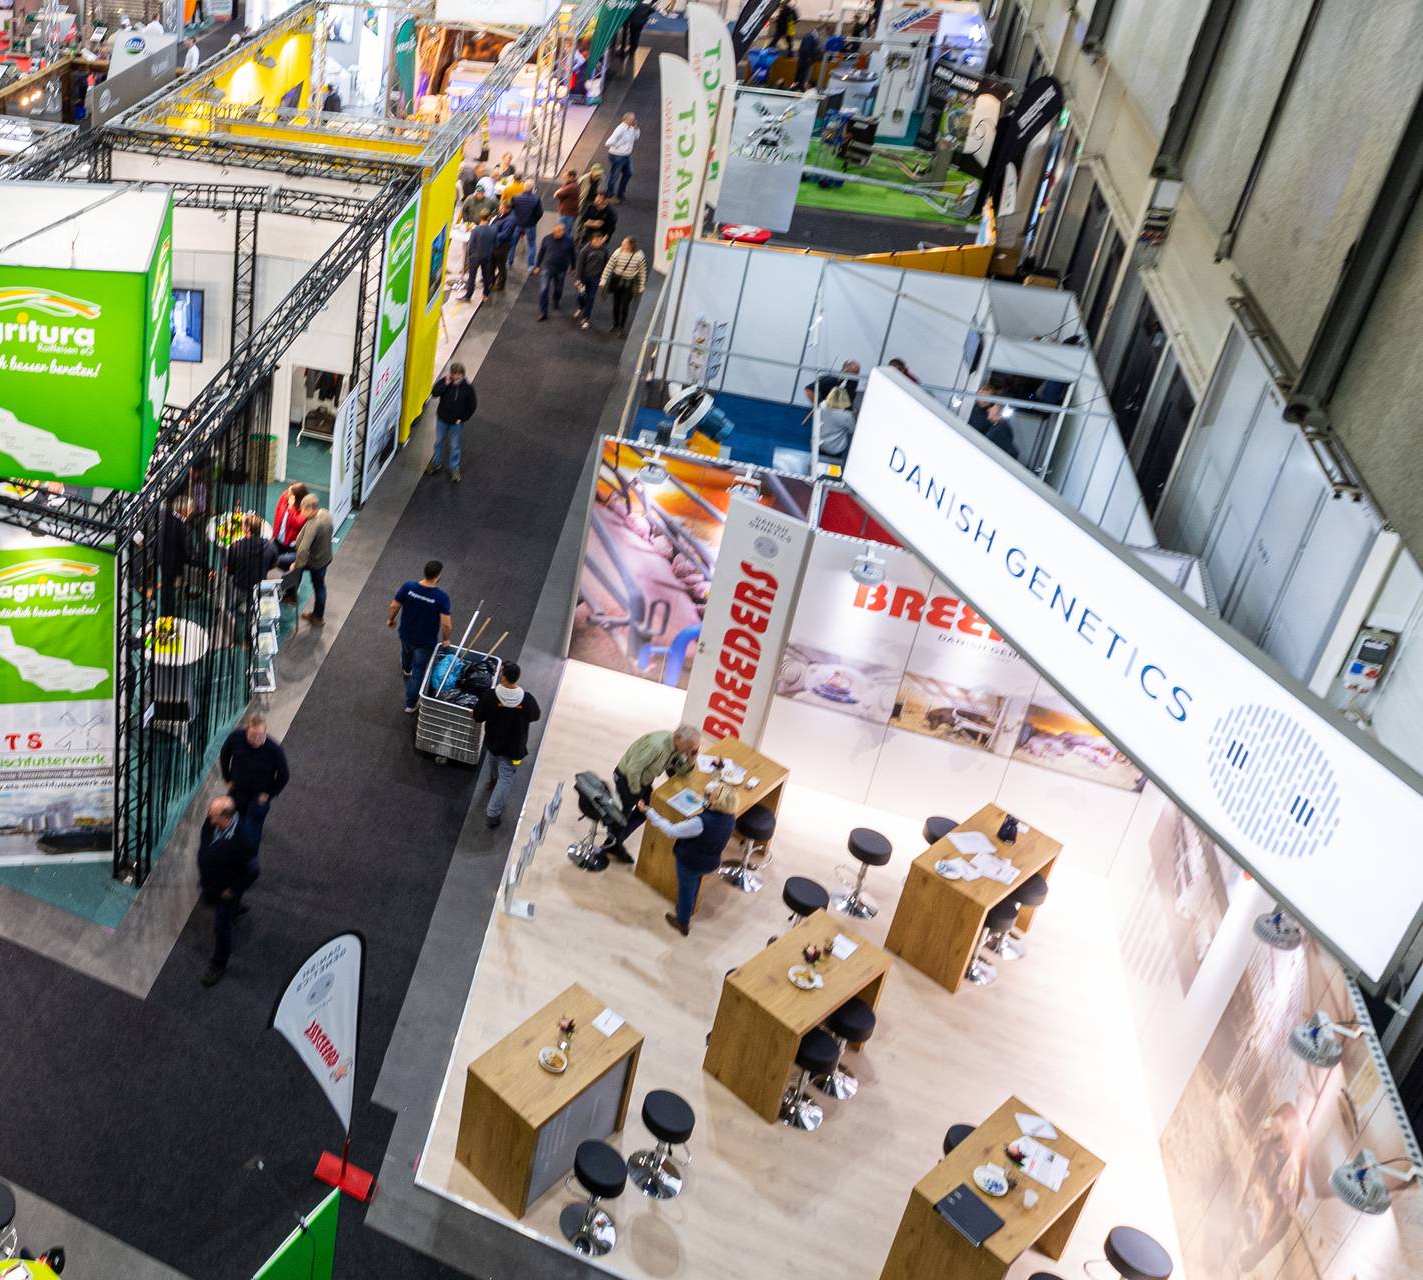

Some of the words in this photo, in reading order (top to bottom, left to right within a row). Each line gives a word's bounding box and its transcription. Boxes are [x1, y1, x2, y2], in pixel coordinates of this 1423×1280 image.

[10, 355, 48, 373] besser
[49, 358, 102, 378] beraten!
[853, 583, 1008, 644] BREE
[889, 446, 997, 553] DANISH
[1005, 547, 1193, 723] GENETICS
[702, 560, 780, 742] BREEDERS
